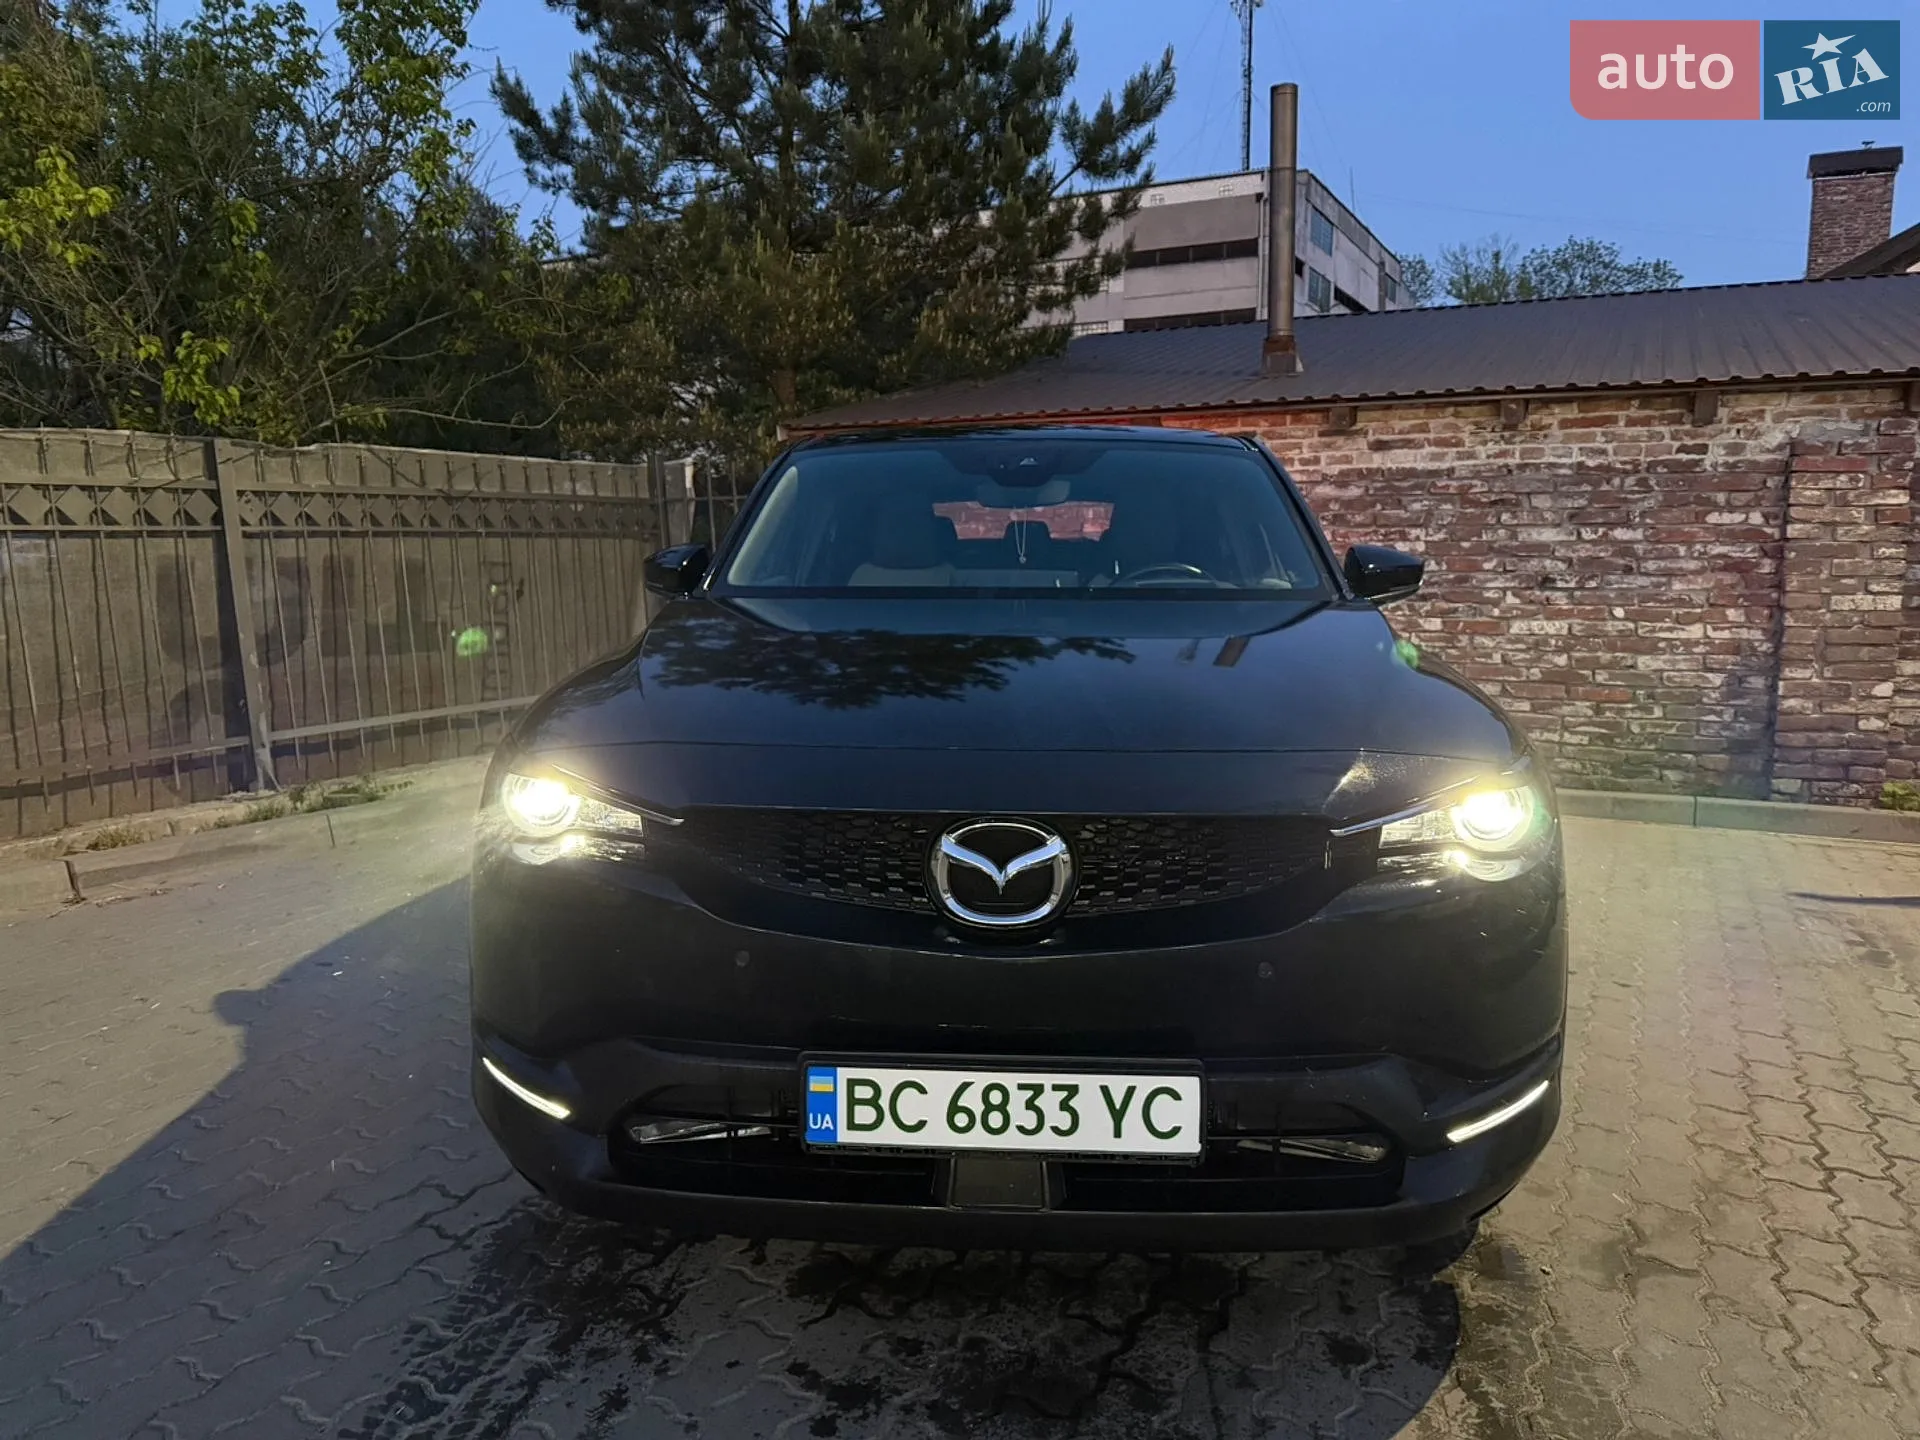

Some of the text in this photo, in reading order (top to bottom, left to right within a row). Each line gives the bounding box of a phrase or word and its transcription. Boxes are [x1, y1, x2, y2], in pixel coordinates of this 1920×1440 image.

[809, 1114, 834, 1131] UA
[846, 1077, 1182, 1140] BC 6833 YC
